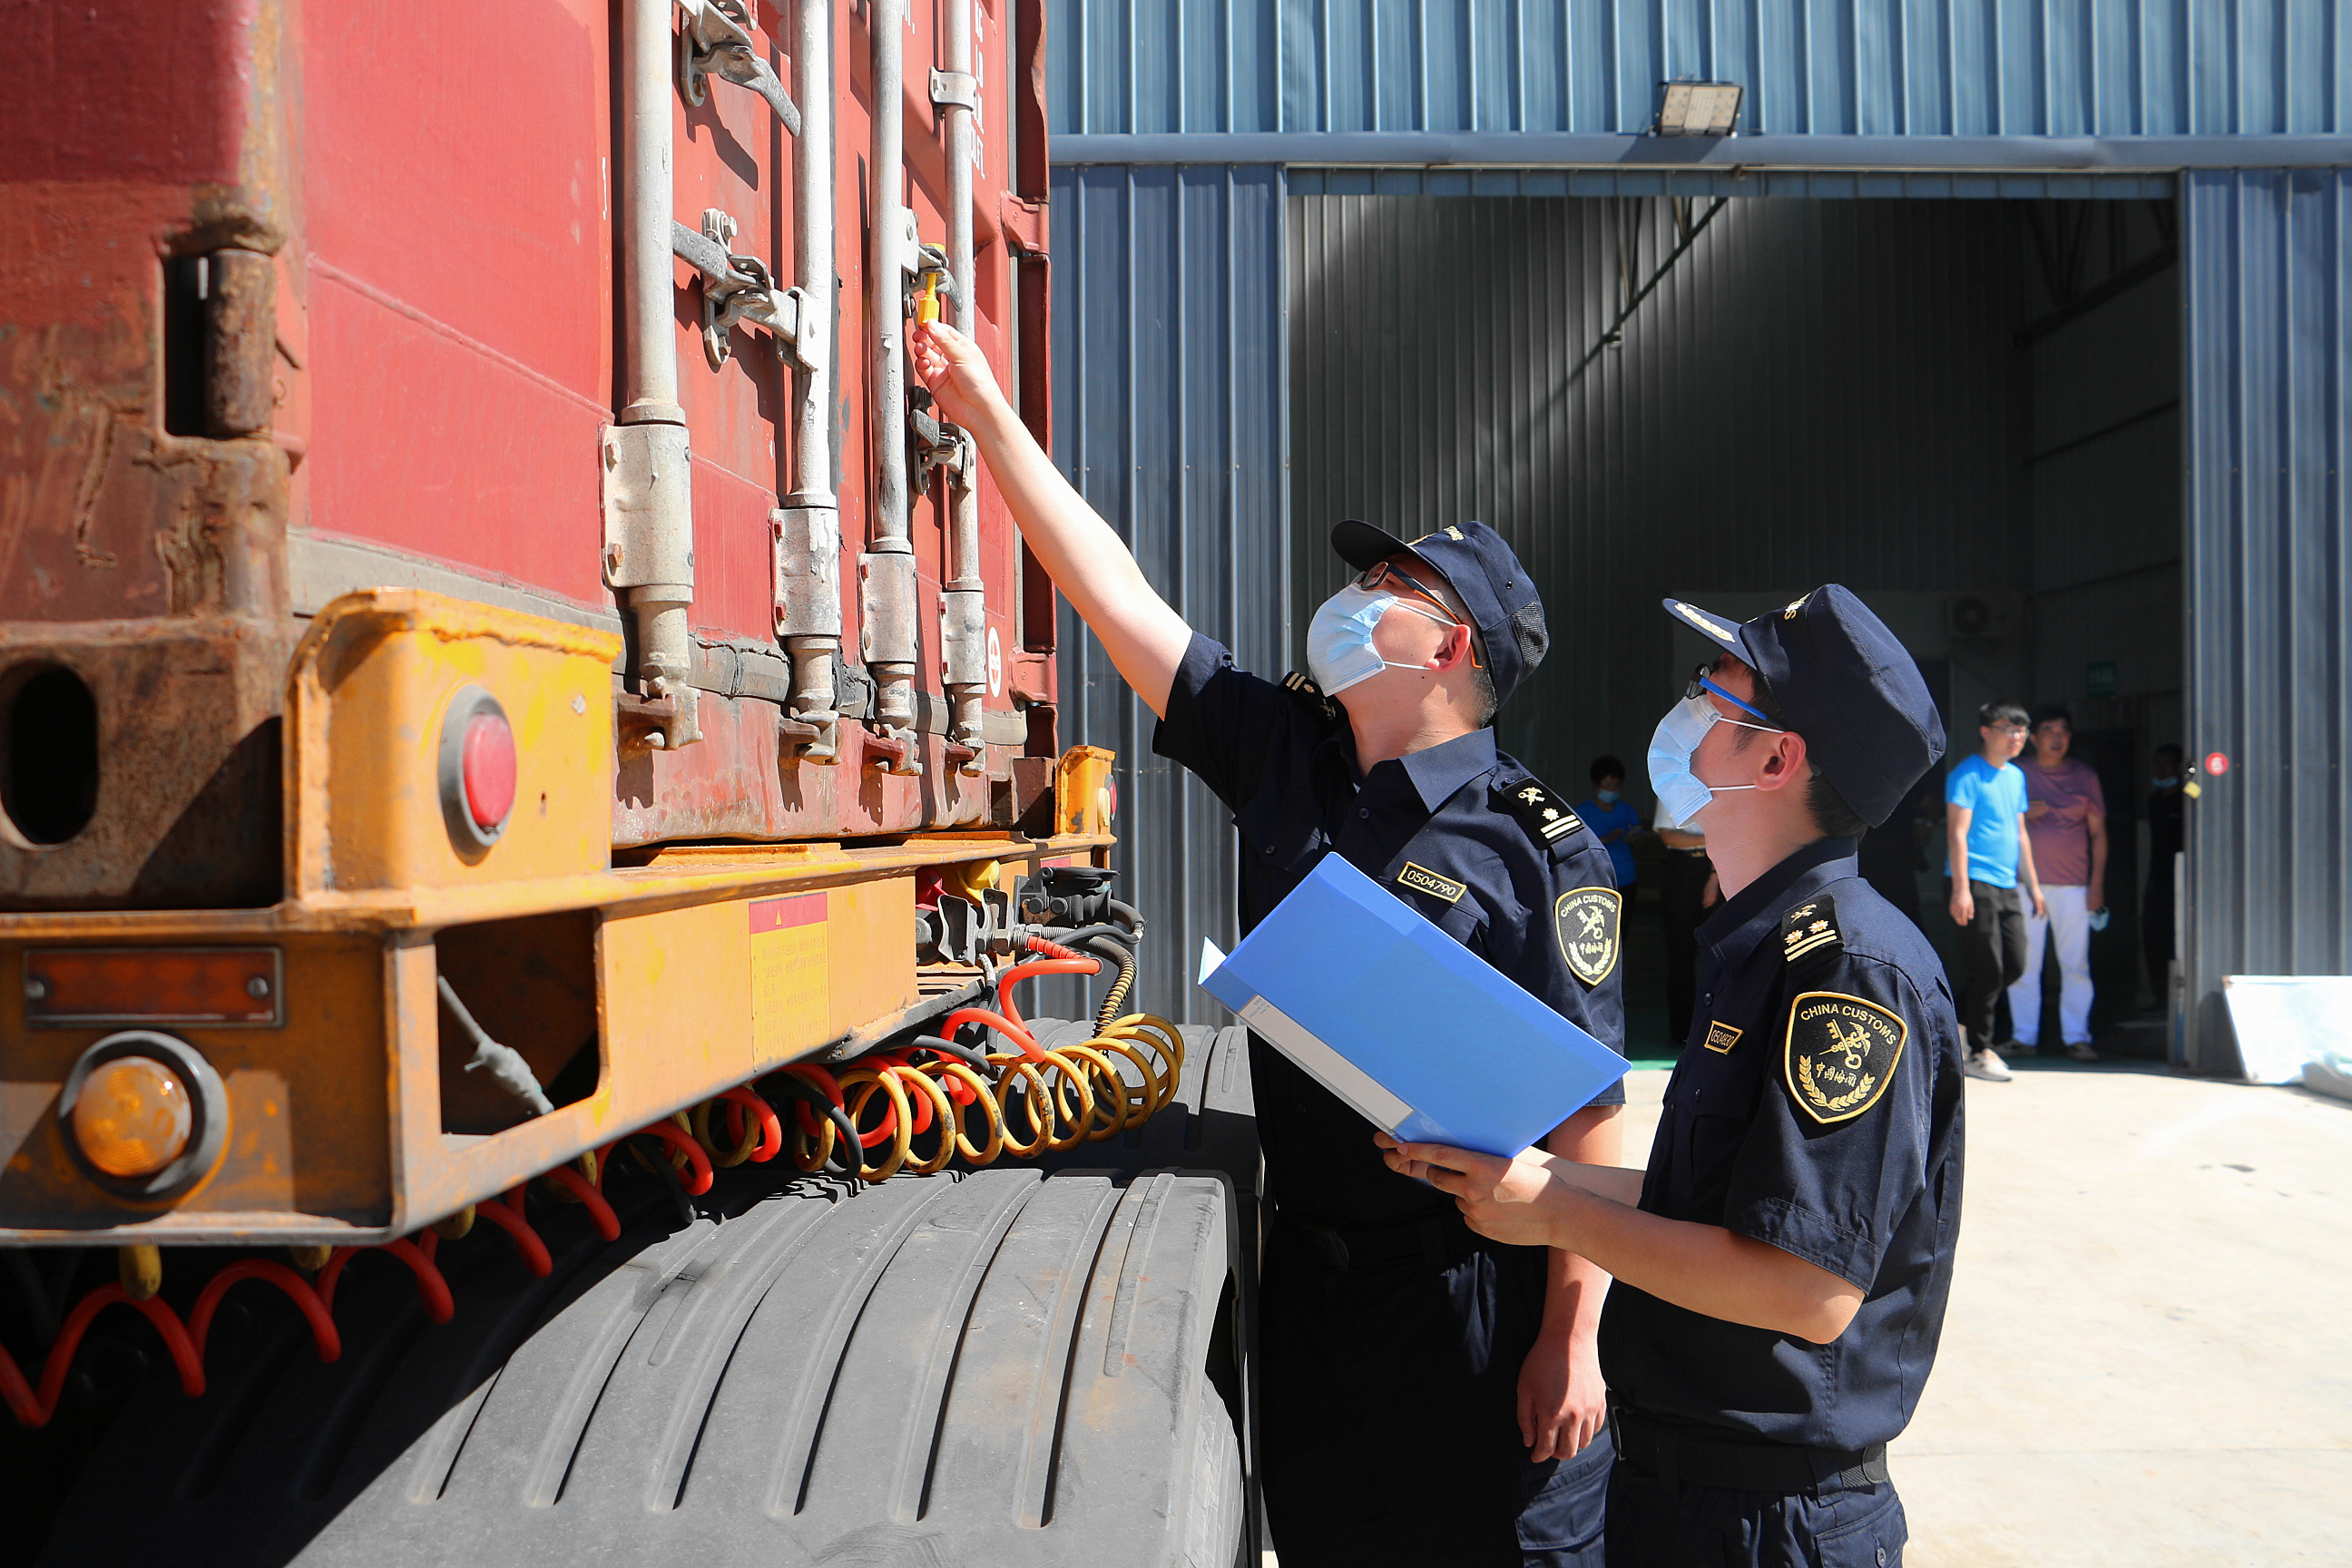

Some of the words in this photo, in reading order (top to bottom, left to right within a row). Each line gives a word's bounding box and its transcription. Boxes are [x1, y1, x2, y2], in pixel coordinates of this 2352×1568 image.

[1406, 869, 1456, 897] 0504790
[1560, 897, 1583, 918] CHINA
[1583, 894, 1617, 913] CUSTOMS
[1799, 1003, 1840, 1021] CHINA
[1841, 1004, 1897, 1045] CUSTOMS
